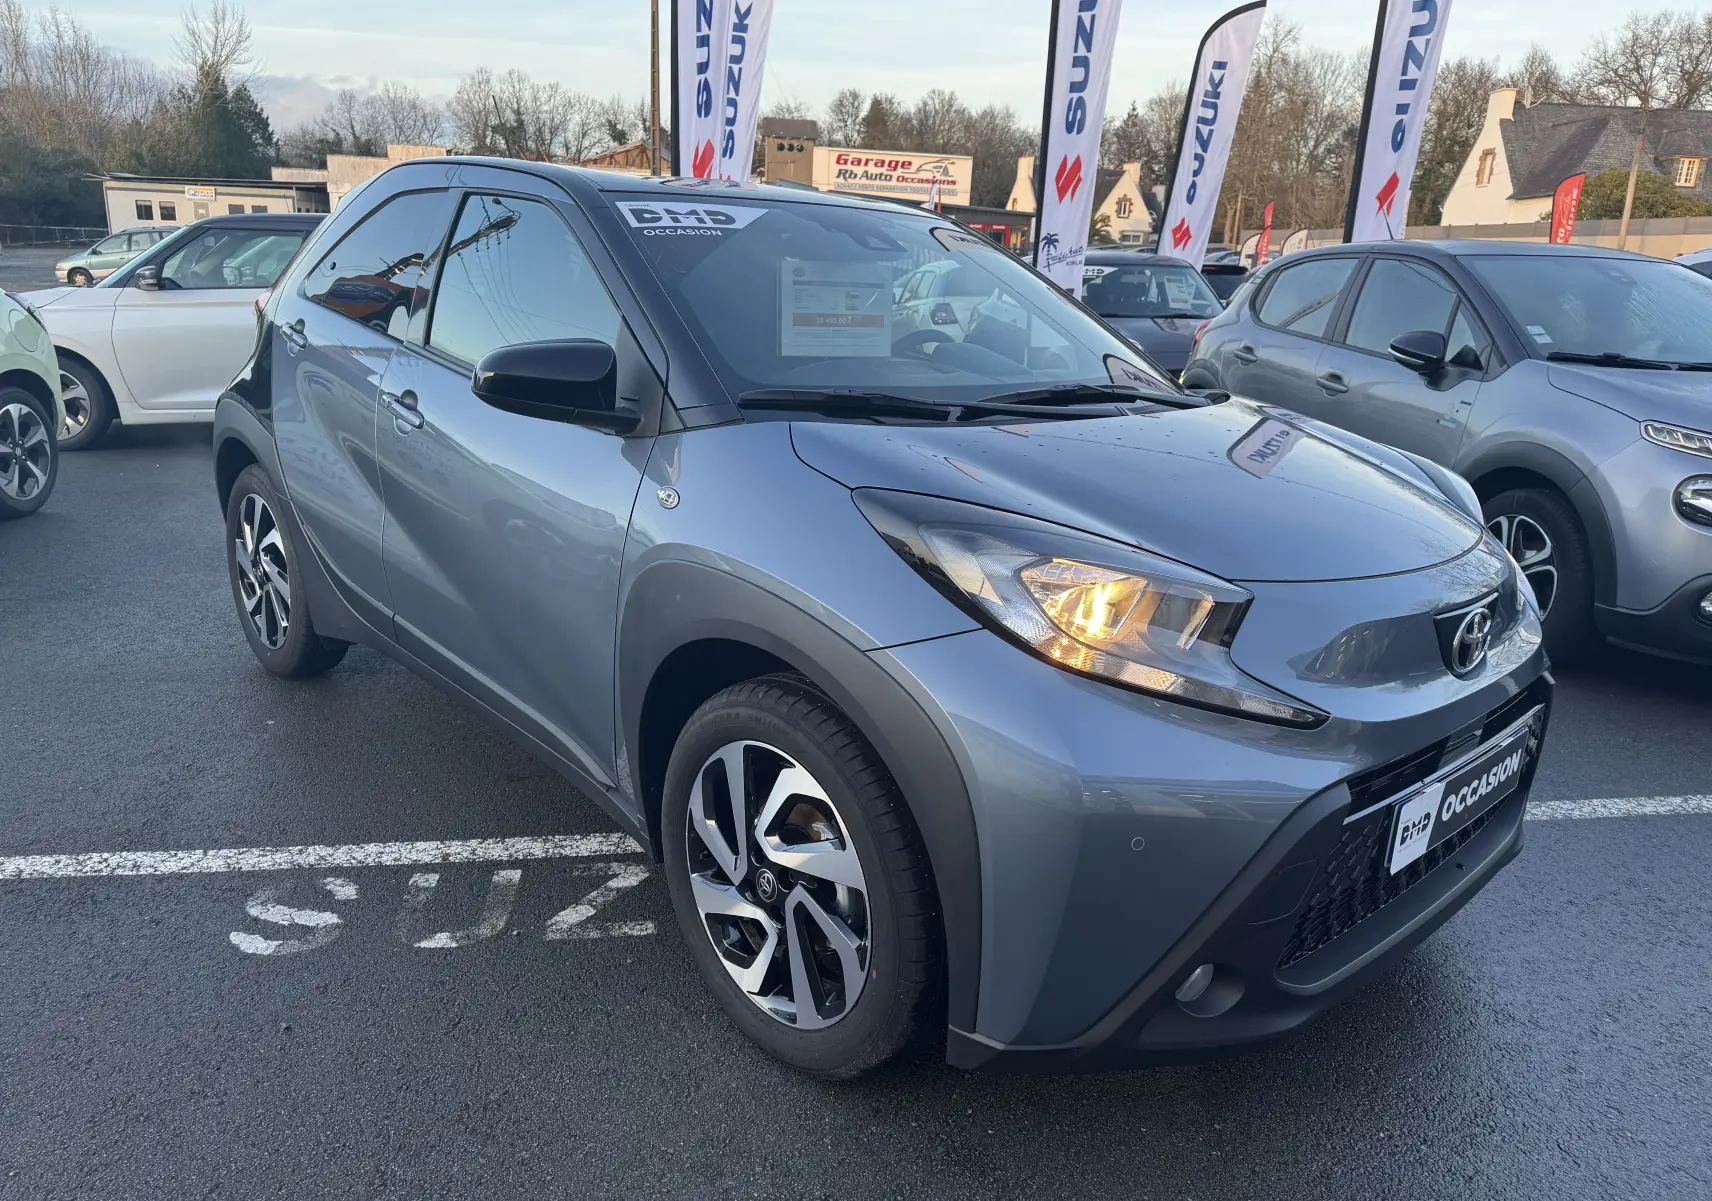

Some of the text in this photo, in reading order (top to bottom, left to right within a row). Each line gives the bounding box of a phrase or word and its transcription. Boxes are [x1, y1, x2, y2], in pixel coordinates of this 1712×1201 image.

[835, 153, 913, 172] Garage
[835, 168, 957, 186] Rb Auto Occasions
[628, 208, 737, 226] DMD
[643, 228, 723, 236] OCCASION
[1399, 811, 1432, 847] DMD
[1441, 748, 1523, 822] OCCASION
